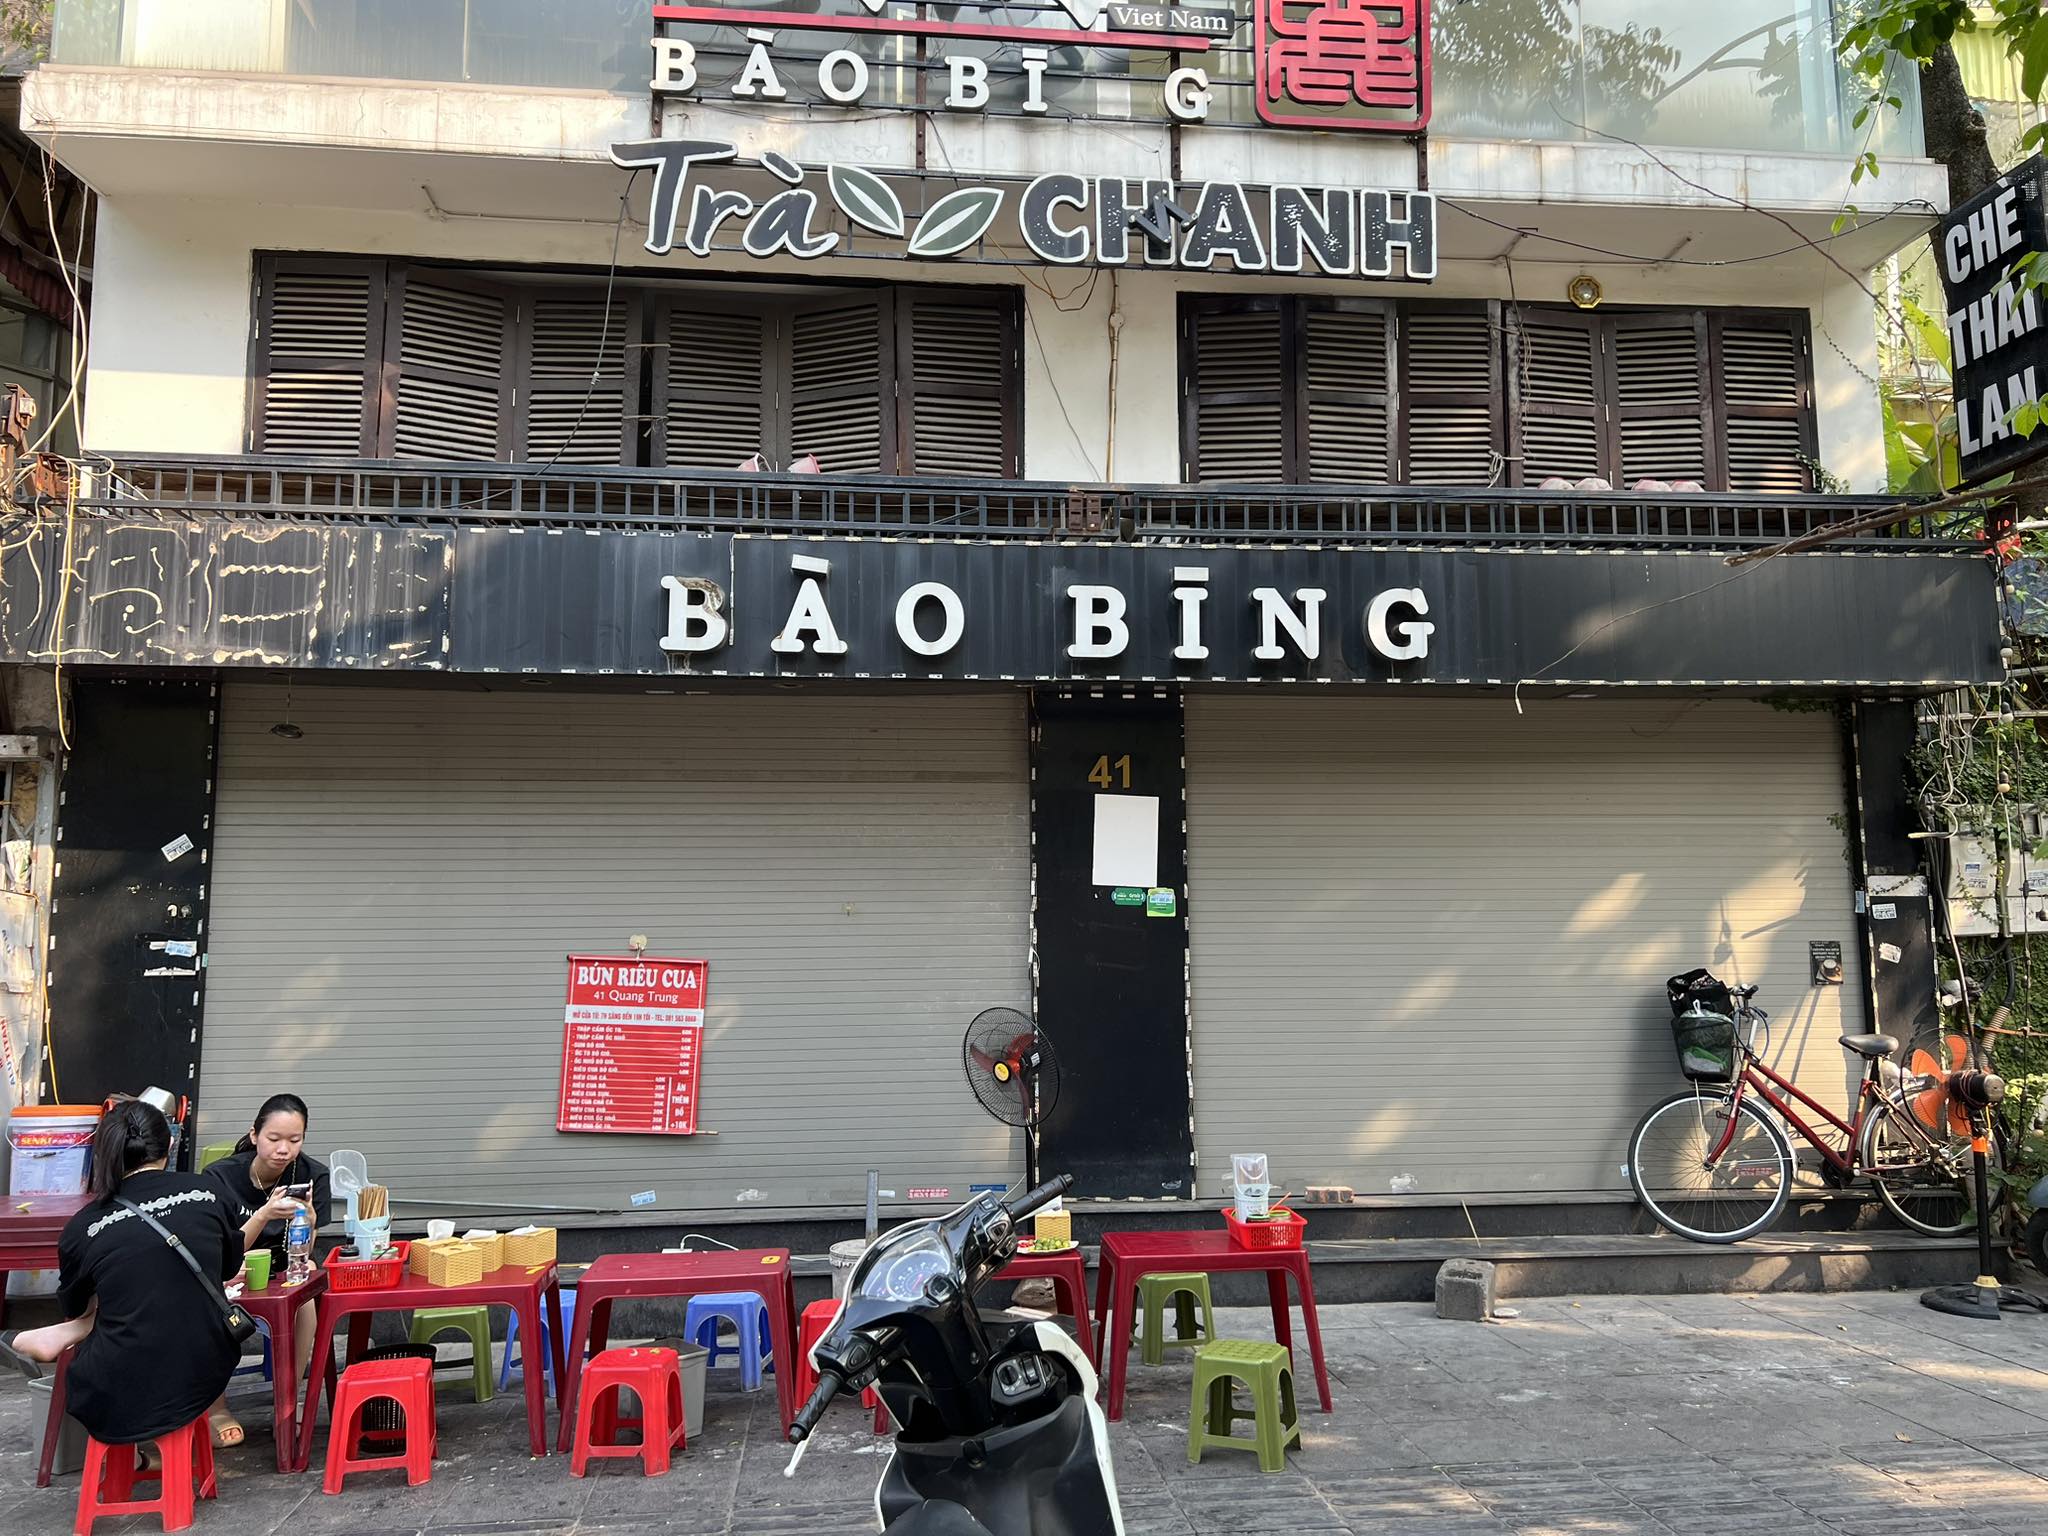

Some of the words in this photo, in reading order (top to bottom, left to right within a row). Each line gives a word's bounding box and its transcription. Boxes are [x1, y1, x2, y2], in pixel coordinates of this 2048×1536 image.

[1114, 6, 1164, 28] Viet
[1169, 9, 1229, 32] Nam
[608, 138, 839, 259] Trà
[1019, 171, 1438, 281] CHANH
[1945, 177, 2022, 284] CHÈ
[1087, 754, 1131, 789] 41
[577, 963, 614, 986] BÚN
[617, 963, 658, 988] RIÊU
[661, 970, 697, 989] CUA
[593, 991, 605, 1000] 41
[609, 989, 644, 1003] Quang
[647, 991, 678, 1004] Trung
